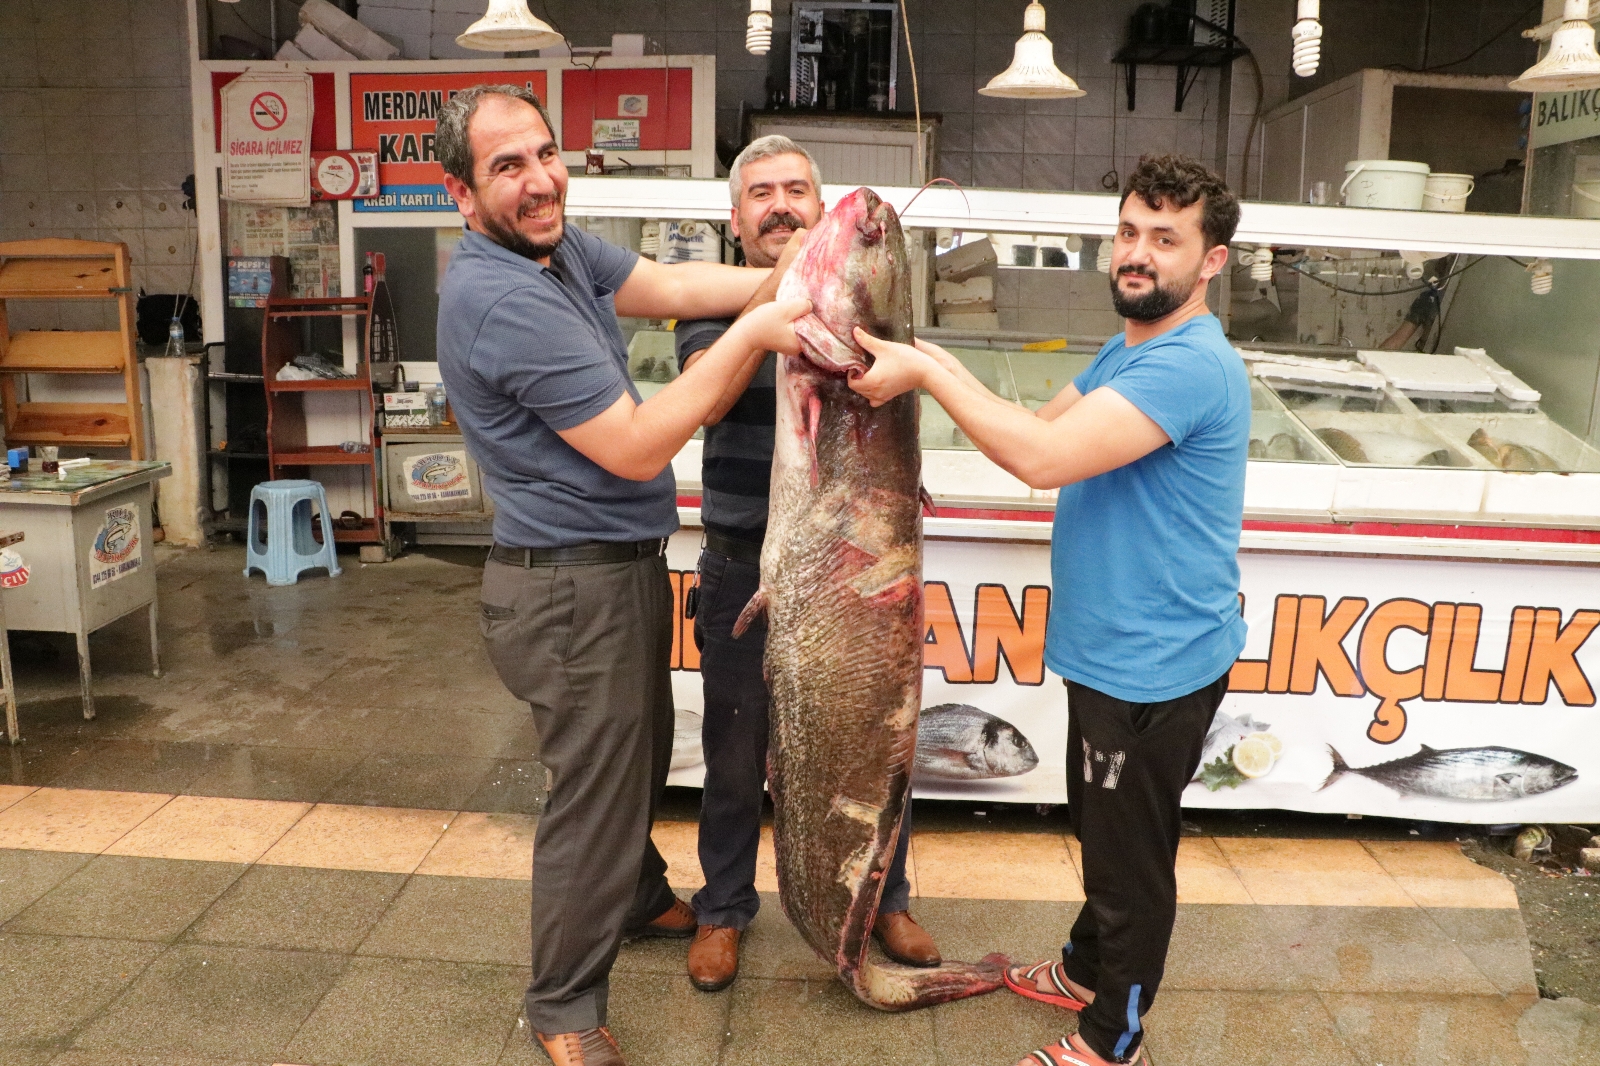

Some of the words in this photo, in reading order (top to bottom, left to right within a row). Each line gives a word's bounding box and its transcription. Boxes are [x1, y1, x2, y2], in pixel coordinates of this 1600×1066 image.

[364, 90, 442, 121] MERDAN
[230, 138, 263, 156] SİGARA
[266, 137, 302, 159] İÇİLMEZ
[379, 133, 441, 164] KAR
[364, 191, 397, 207] KREDİ
[401, 193, 433, 206] KARTI
[437, 191, 455, 206] İLE
[924, 581, 1051, 686] AN
[1227, 593, 1600, 744] LIKÇILIK
